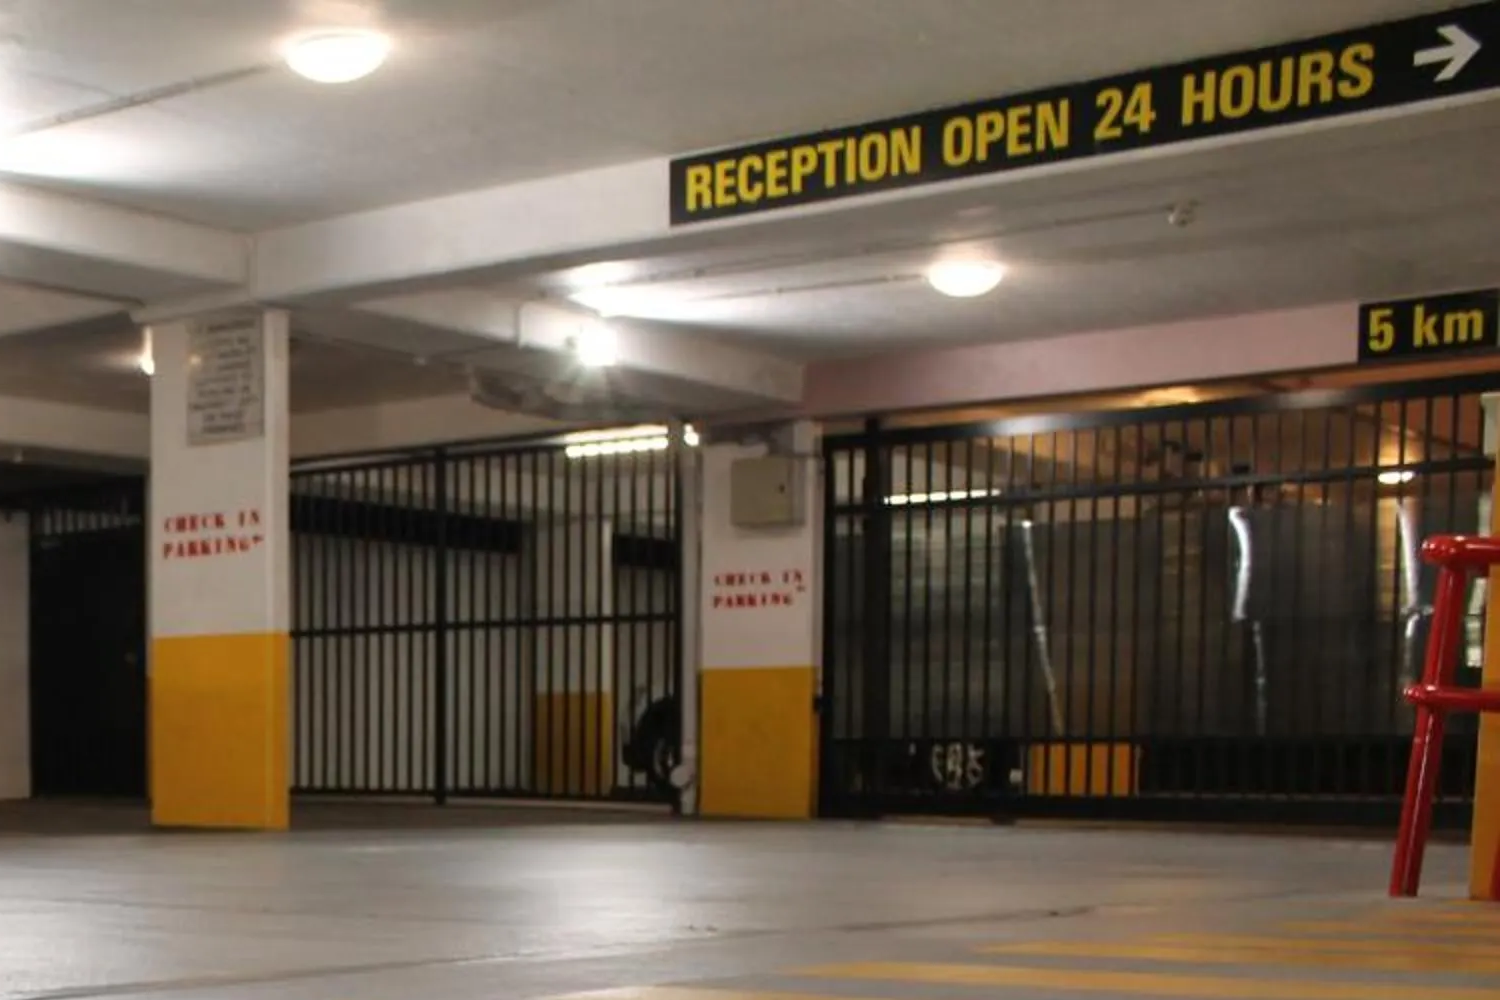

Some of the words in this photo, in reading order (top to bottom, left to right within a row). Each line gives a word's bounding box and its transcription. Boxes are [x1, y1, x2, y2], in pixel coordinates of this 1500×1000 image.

[685, 126, 922, 213] RECEPTION
[943, 99, 1071, 167] OPEN
[1093, 83, 1157, 142] 24
[1182, 42, 1376, 128] HOURS
[1368, 308, 1395, 353] 5
[1413, 303, 1484, 349] km
[163, 512, 226, 534] CHECK
[238, 508, 261, 527] IN
[163, 535, 251, 561] PARKING
